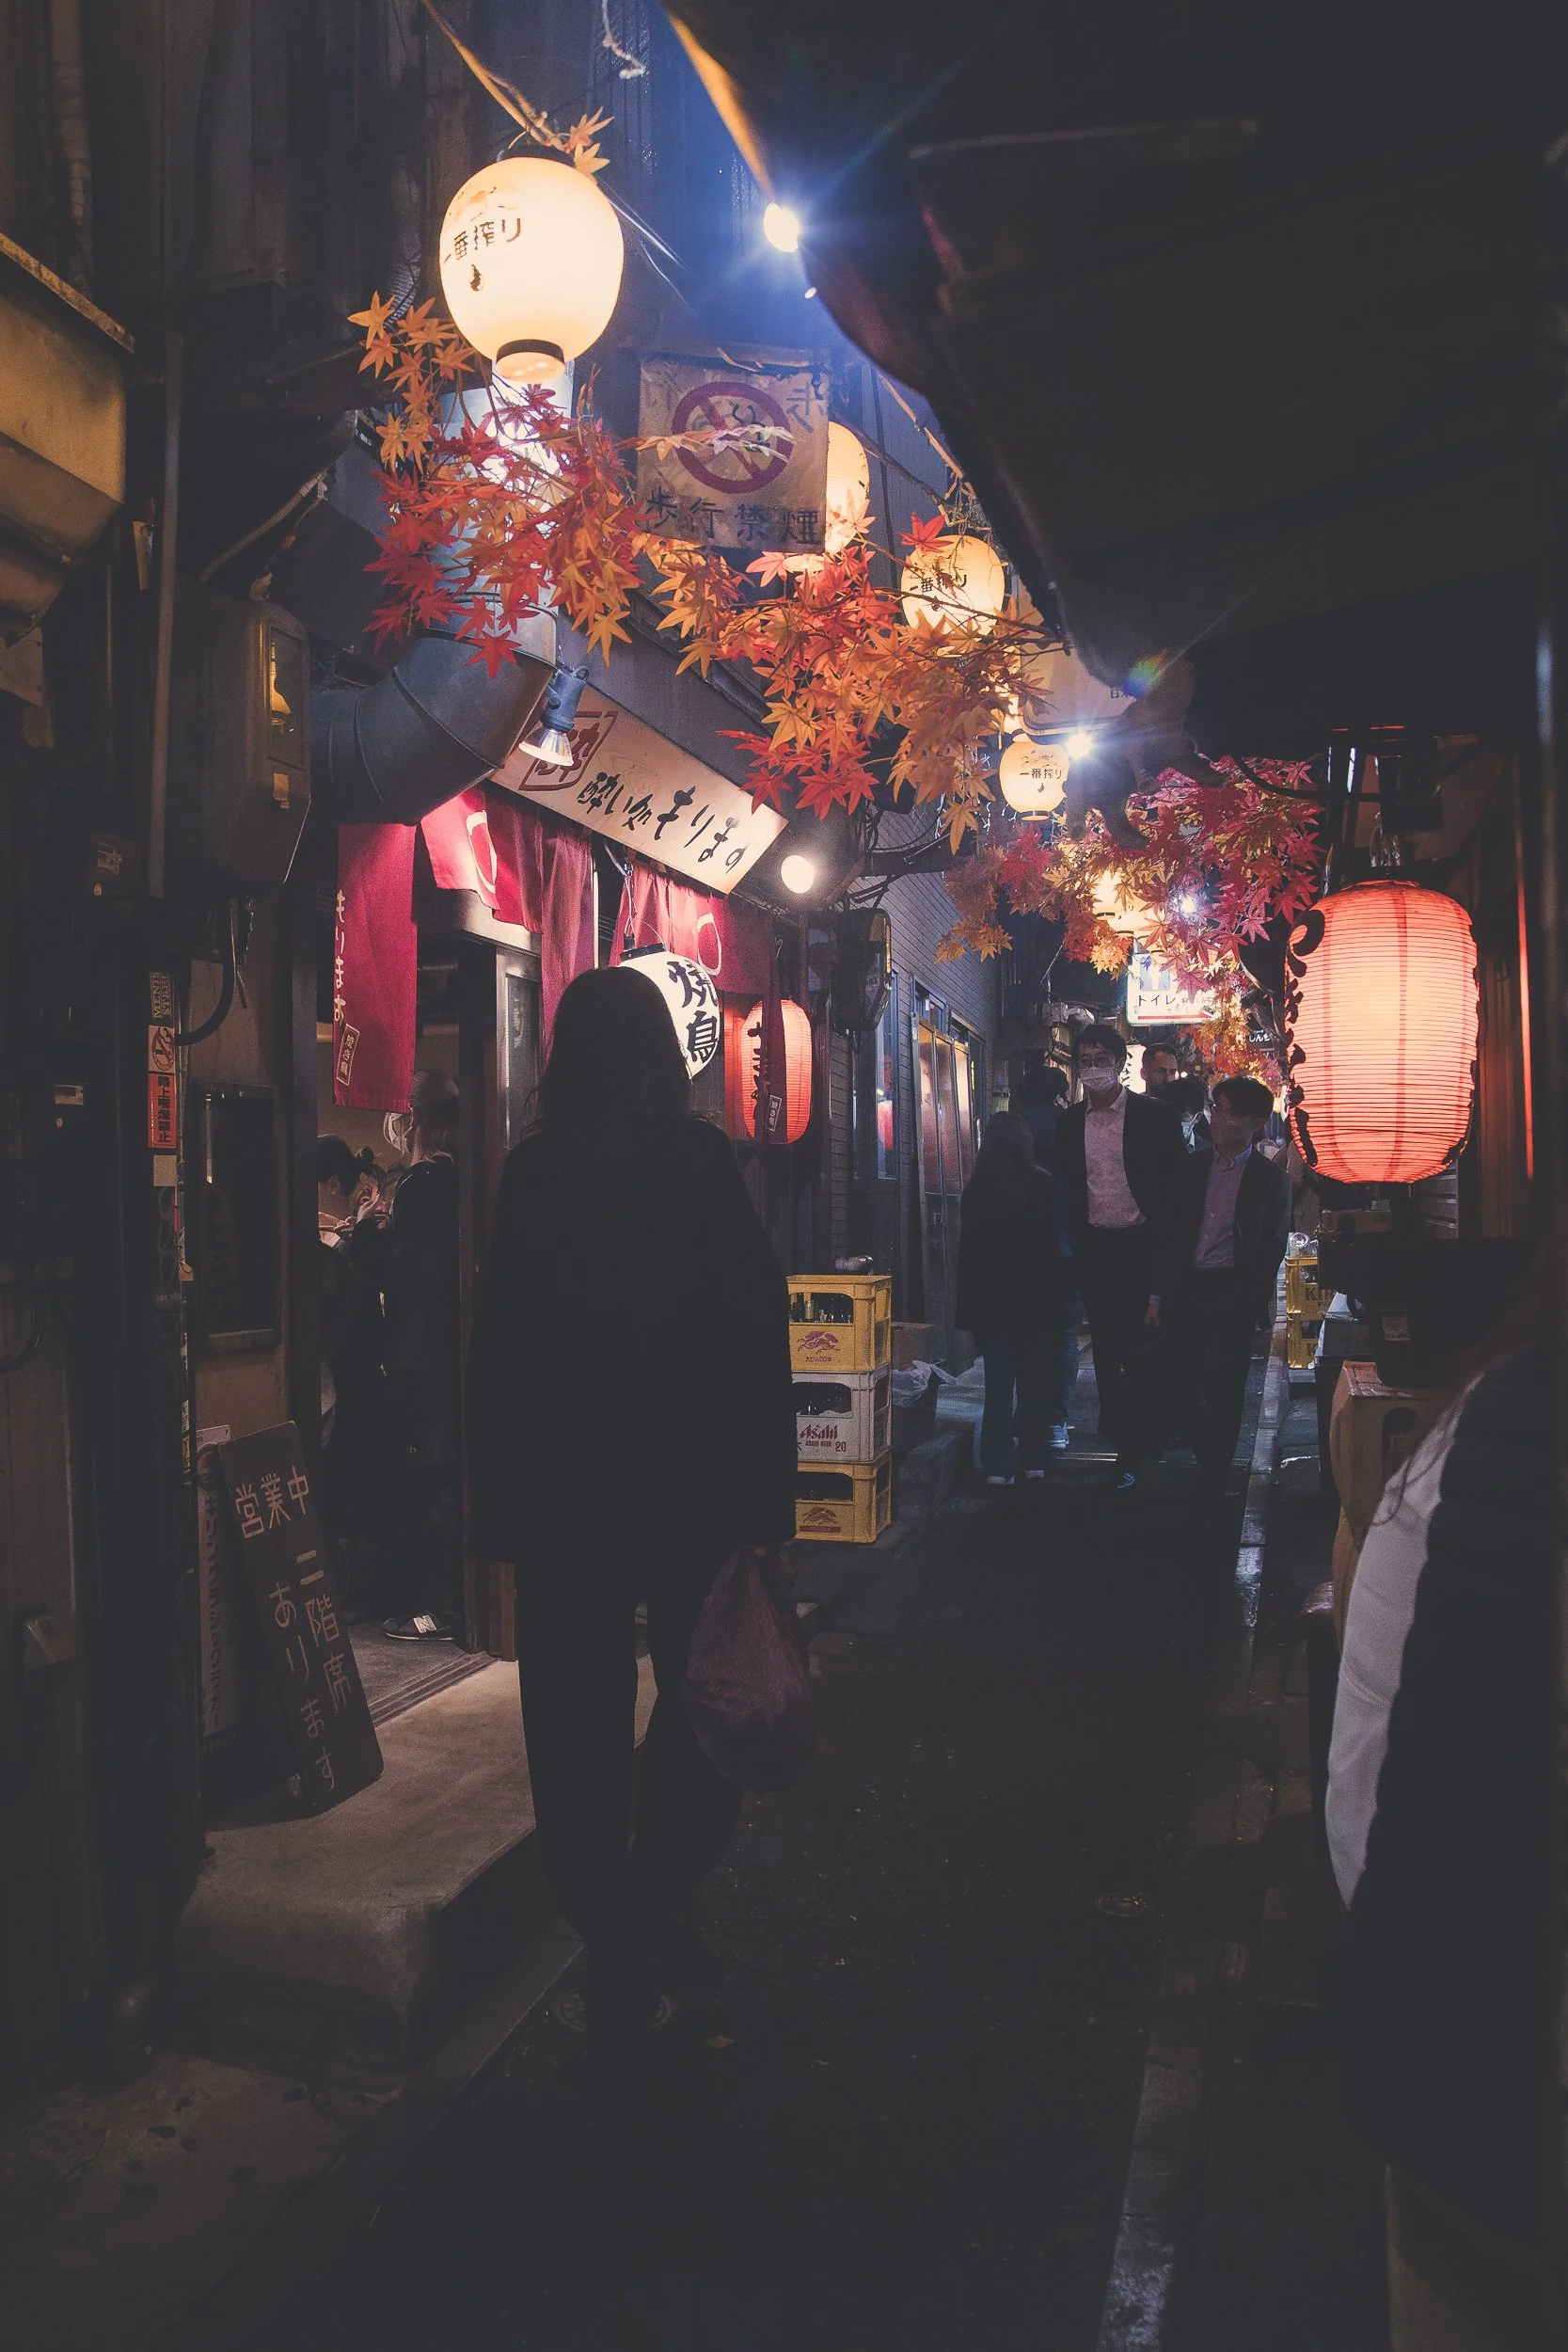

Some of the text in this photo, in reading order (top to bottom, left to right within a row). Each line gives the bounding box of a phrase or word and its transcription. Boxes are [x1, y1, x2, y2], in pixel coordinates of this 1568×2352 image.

[1019, 768, 1063, 780] 一番搾り
[1138, 994, 1176, 1008] トイレ
[800, 1423, 838, 1439] Asahi
[835, 1441, 847, 1453] 20
[234, 1465, 310, 1540] 営業中
[295, 1549, 354, 1716] 二階席
[269, 1581, 337, 1792] あります
